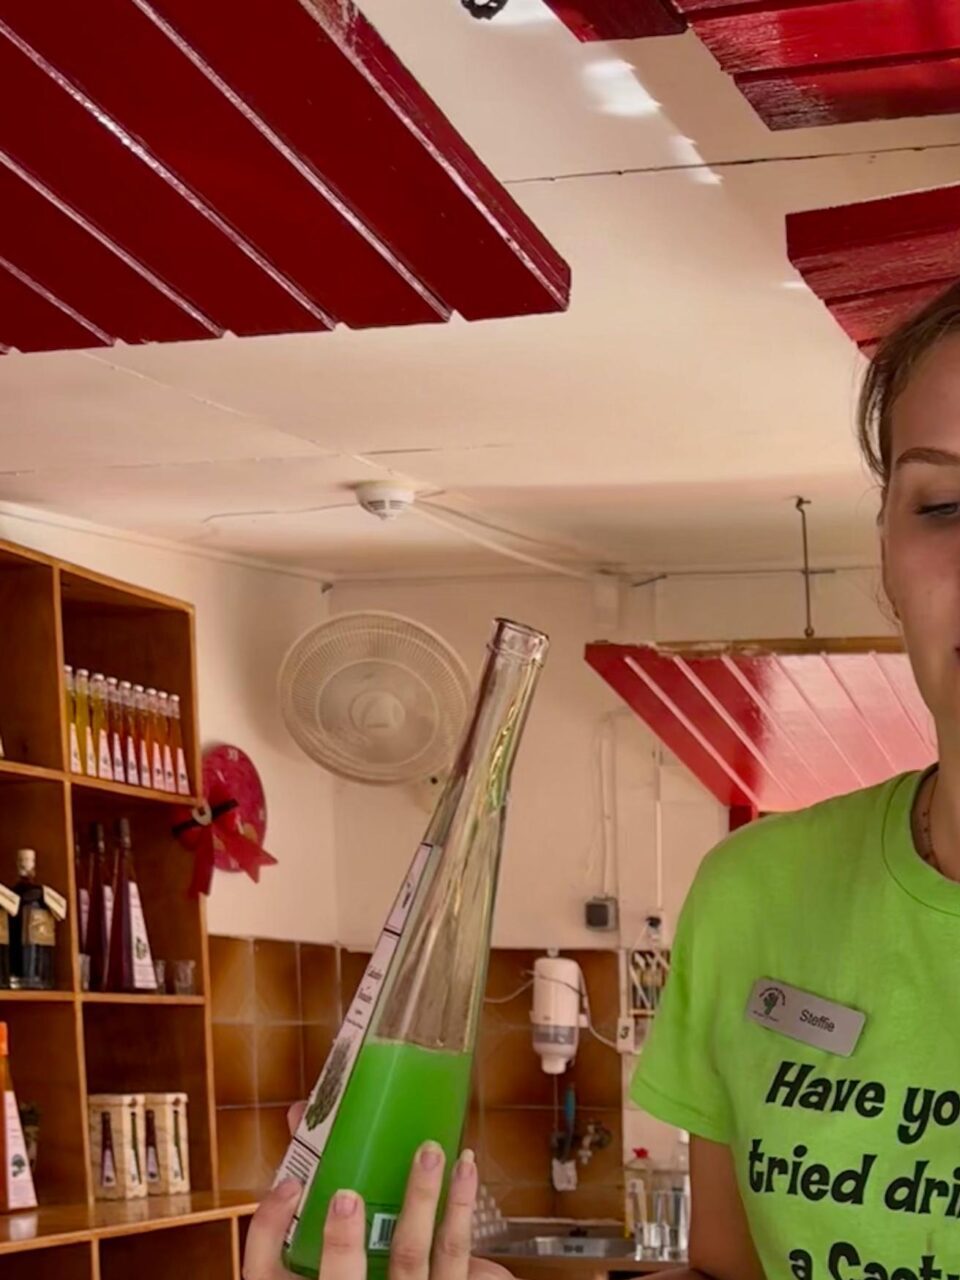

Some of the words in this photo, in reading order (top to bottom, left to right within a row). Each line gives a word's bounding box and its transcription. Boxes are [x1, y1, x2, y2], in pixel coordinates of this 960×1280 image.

[799, 1008, 836, 1034] Steffie
[764, 1060, 886, 1118] Have
[748, 1138, 878, 1206] tried
